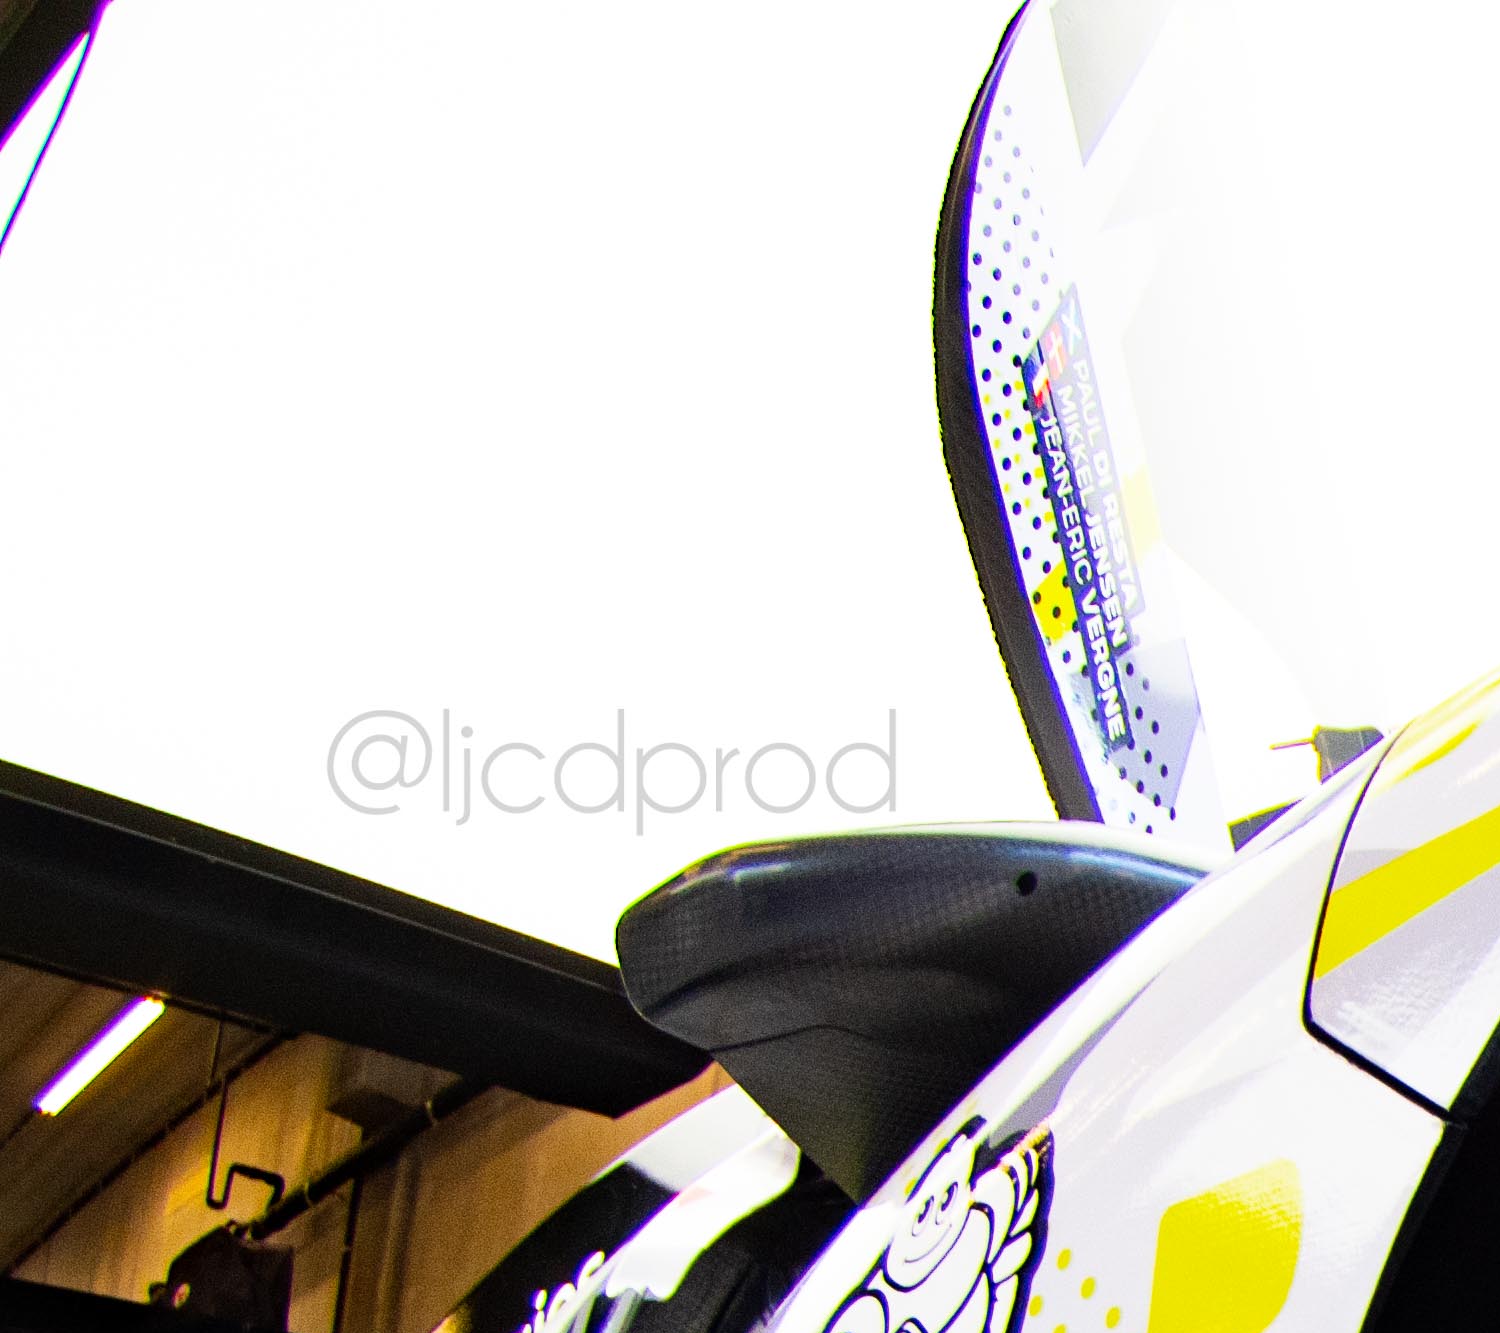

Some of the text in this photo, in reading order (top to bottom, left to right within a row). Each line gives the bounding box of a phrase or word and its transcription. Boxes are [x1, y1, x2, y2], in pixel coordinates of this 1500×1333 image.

[1040, 414, 1126, 742] JEAN-ERIC VERGNE
[1056, 384, 1129, 658] MIKKEL JENSEN
